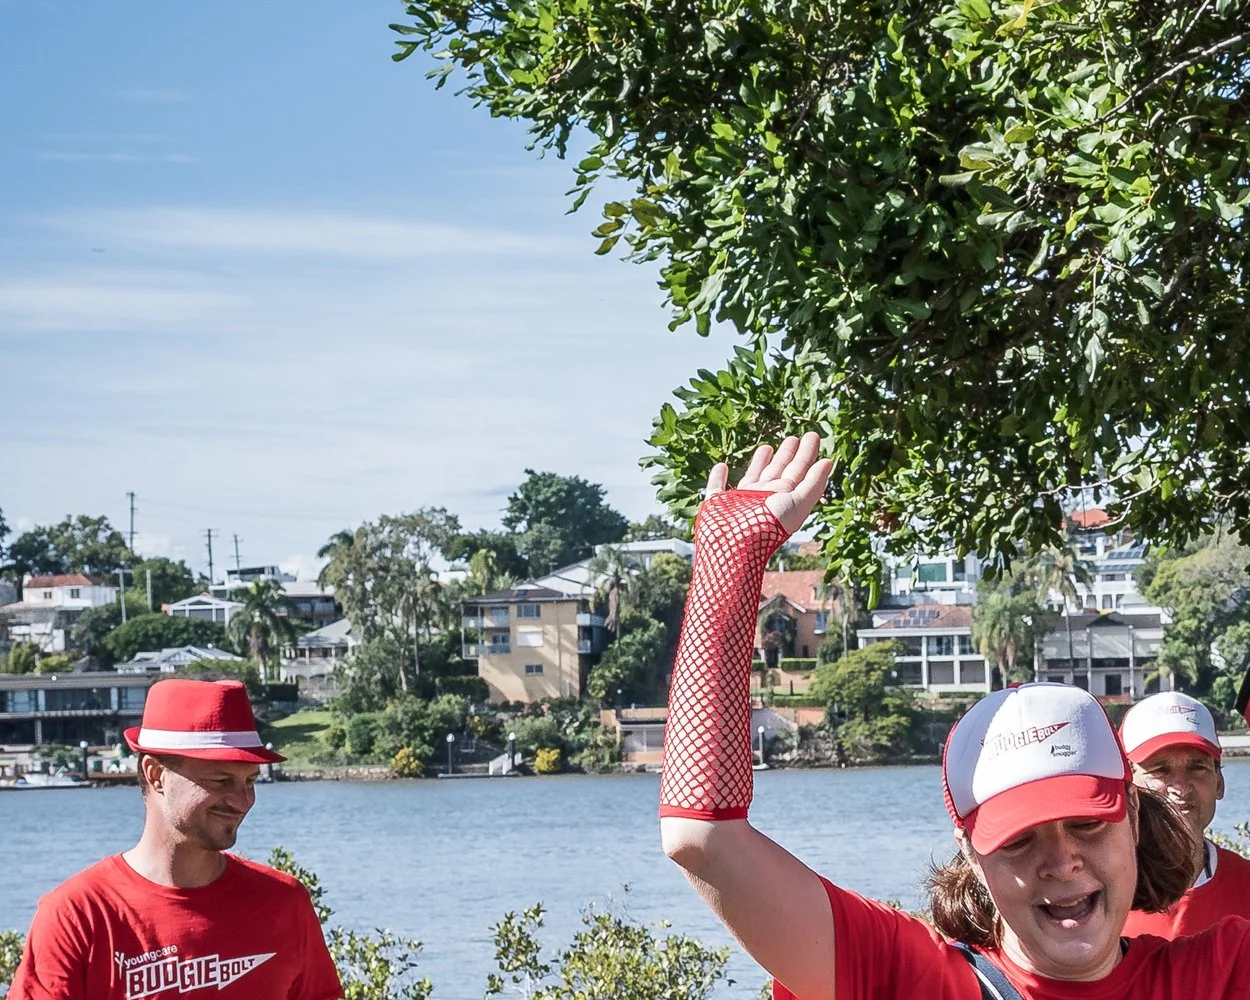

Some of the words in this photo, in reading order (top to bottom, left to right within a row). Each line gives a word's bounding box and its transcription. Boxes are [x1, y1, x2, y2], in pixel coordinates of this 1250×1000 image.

[123, 944, 178, 970] youngcare
[128, 956, 218, 998] BUDGIE
[219, 957, 256, 983] BOLT
